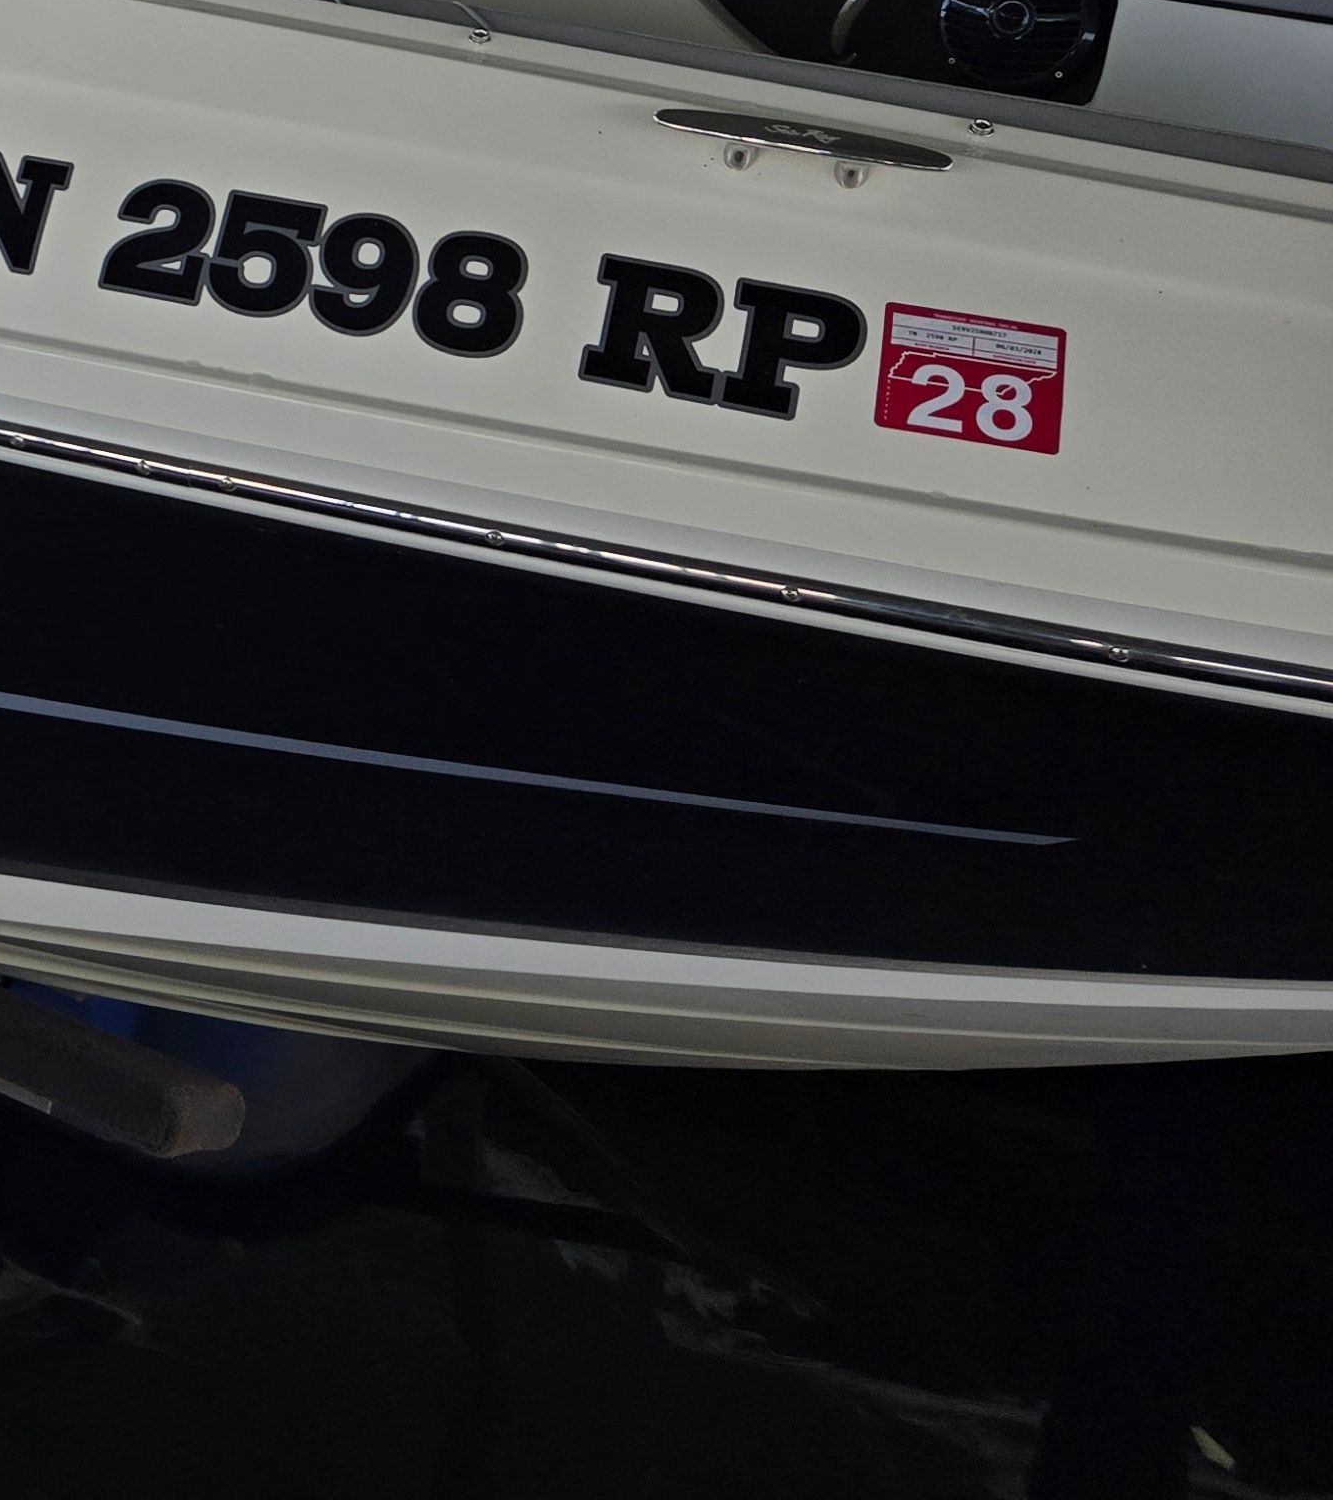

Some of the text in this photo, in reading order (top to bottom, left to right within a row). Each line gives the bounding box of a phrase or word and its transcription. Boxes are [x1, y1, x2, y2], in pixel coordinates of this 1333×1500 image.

[98, 178, 529, 358] 2598
[578, 253, 868, 421] RP
[907, 364, 1033, 442] 28
